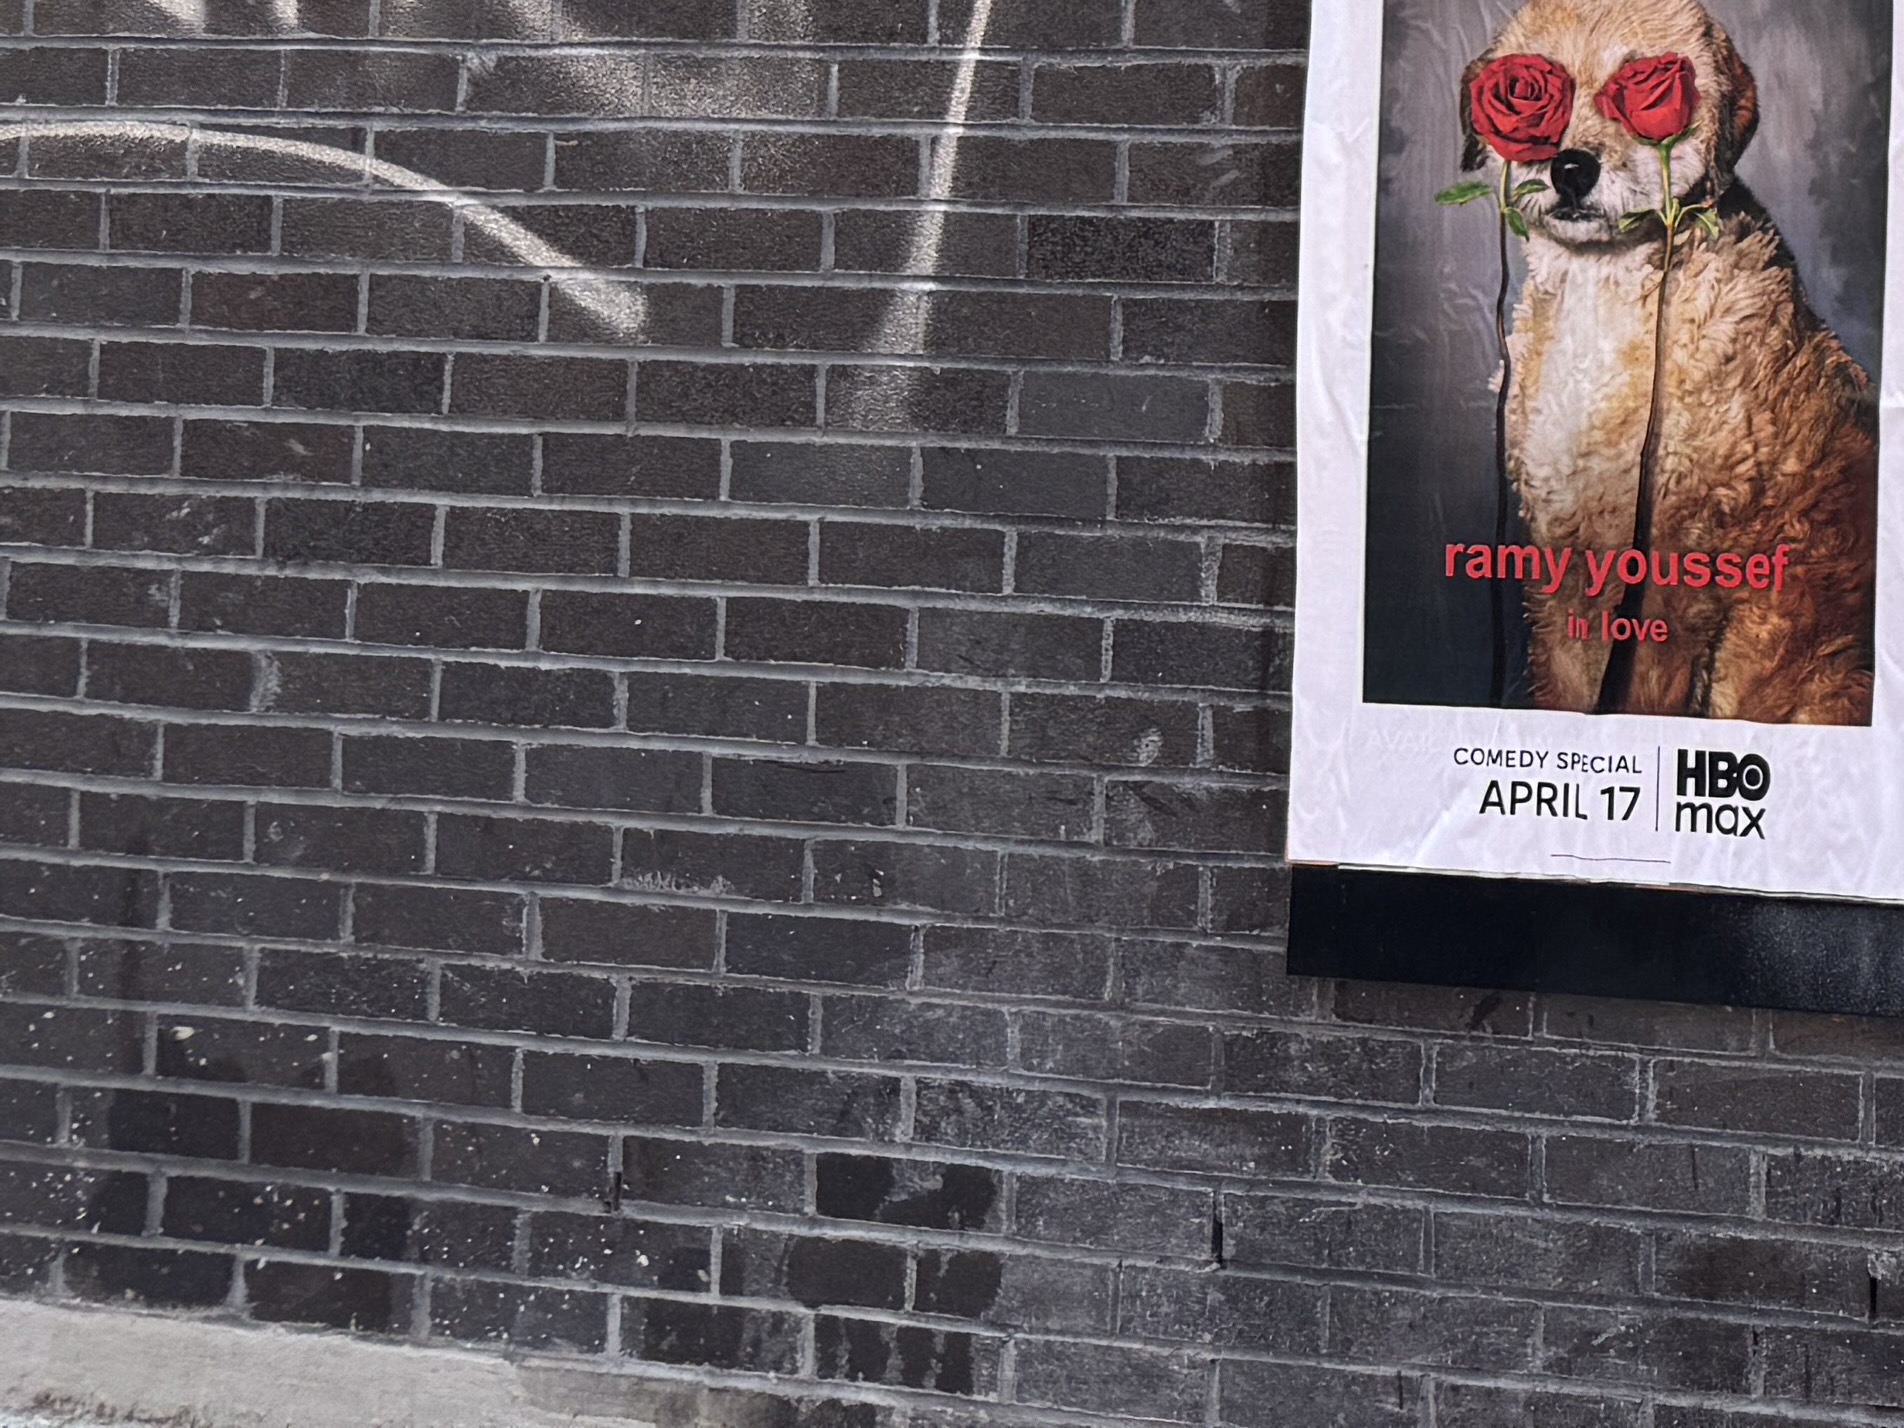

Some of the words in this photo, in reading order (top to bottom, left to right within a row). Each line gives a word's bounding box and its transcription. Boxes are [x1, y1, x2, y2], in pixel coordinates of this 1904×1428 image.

[1445, 543, 1571, 594] ramy
[1584, 542, 1792, 596] youssef
[1568, 610, 1588, 638] in
[1602, 611, 1667, 641] love
[1454, 748, 1548, 768] COMEDY
[1557, 752, 1642, 773] SPECIAL
[1677, 749, 1770, 801] HBO
[1479, 780, 1587, 820] APRIL
[1601, 787, 1640, 820] 17
[1676, 801, 1765, 839] max
